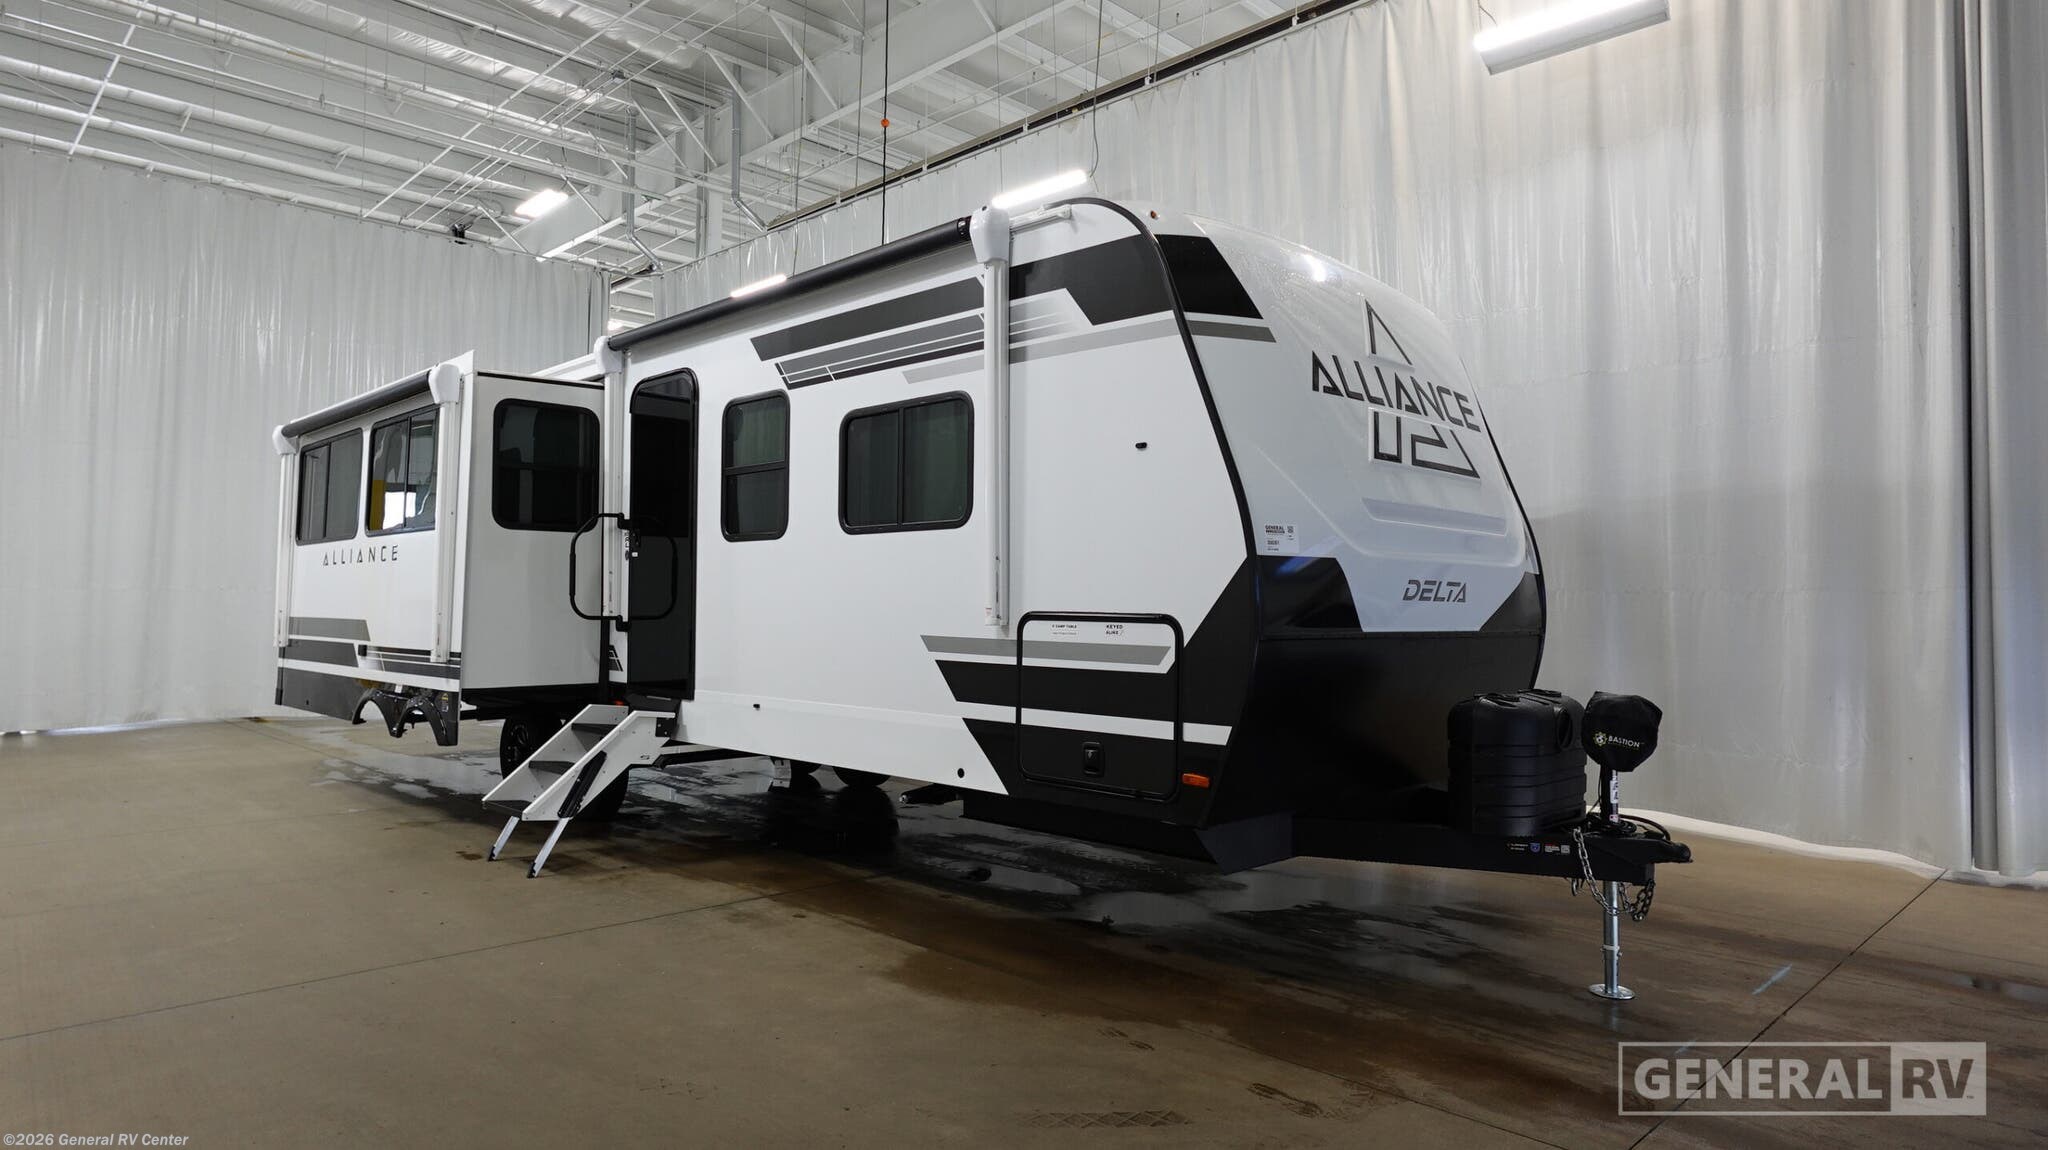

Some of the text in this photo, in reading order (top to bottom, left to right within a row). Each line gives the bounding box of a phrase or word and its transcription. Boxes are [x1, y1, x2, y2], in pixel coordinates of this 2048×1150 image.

[1312, 350, 1481, 433] ALLIANCE
[323, 545, 399, 566] ALLIANCE
[1403, 579, 1467, 603] DELTA
[1608, 735, 1640, 748] BASTION
